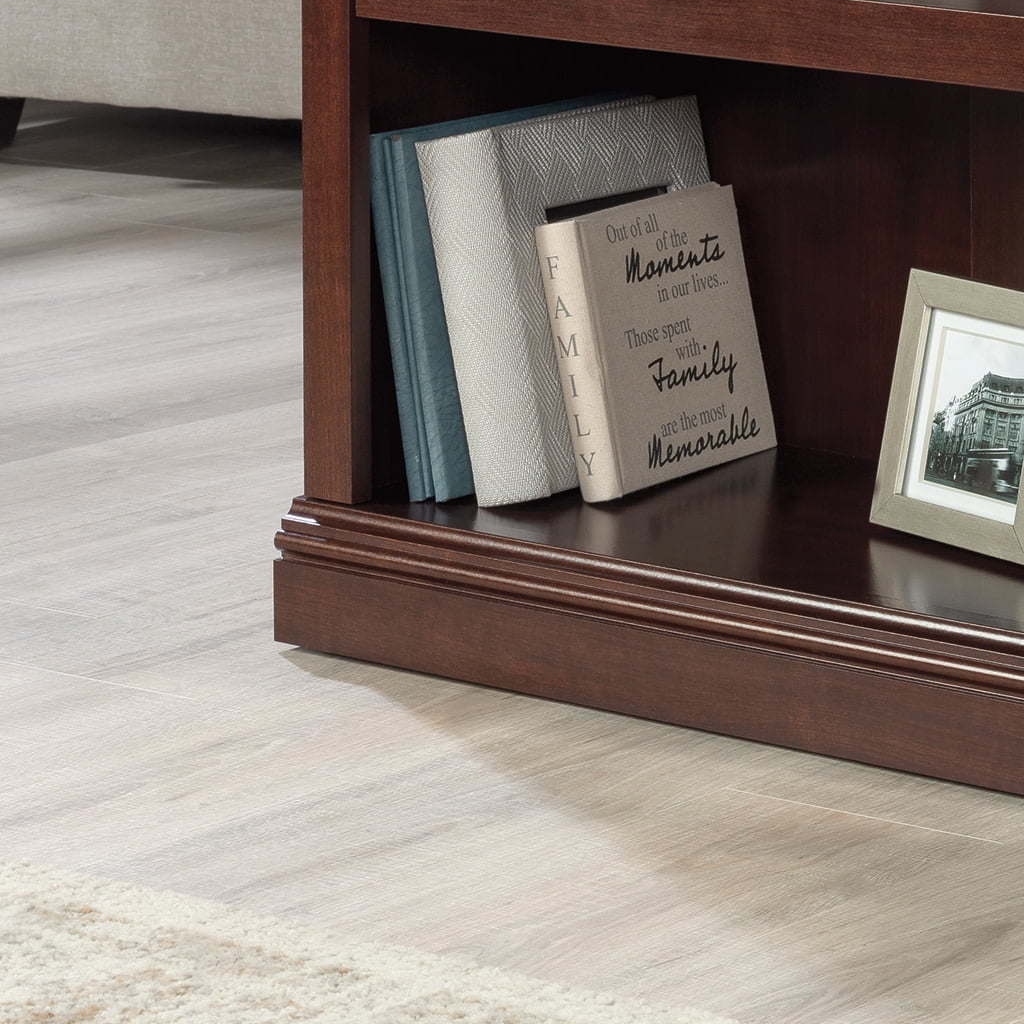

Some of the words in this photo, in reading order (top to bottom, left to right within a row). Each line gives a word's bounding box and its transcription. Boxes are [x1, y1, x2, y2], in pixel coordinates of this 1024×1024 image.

[605, 223, 628, 244] Out
[630, 216, 642, 238] of
[644, 213, 659, 234] all
[655, 230, 668, 252] of
[670, 228, 689, 249] the
[625, 233, 725, 284] Moments
[656, 283, 670, 303] in
[671, 282, 690, 299] our
[691, 272, 729, 293] lives...
[624, 325, 659, 349] Those
[661, 315, 692, 343] spent
[675, 337, 701, 360] with
[545, 256, 597, 477] FAMILY
[647, 339, 738, 395] Family
[648, 405, 761, 469] Memorable
[660, 420, 678, 438] are
[680, 411, 698, 431] the
[698, 403, 727, 426] most
